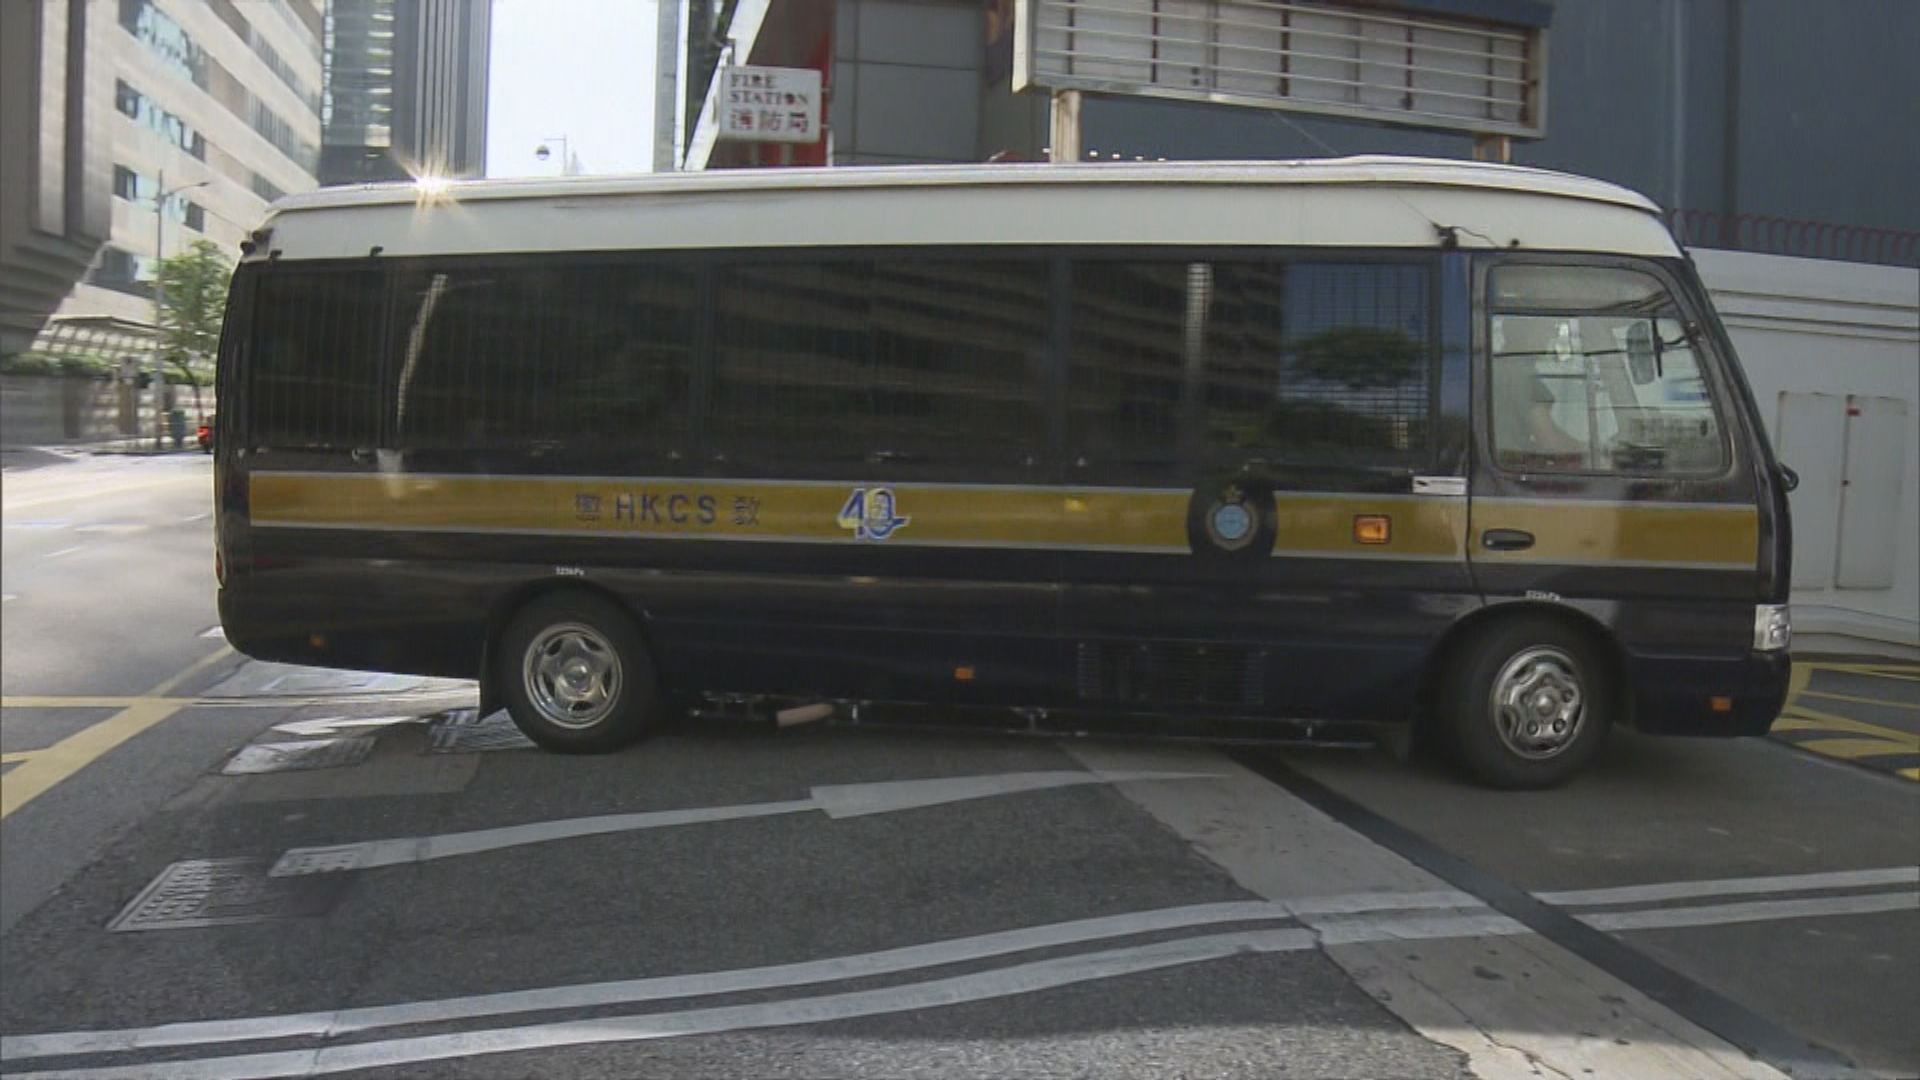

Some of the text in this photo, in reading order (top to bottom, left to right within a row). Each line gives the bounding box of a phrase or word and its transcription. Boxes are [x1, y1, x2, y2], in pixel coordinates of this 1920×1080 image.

[730, 73, 777, 89] FIRE
[729, 90, 809, 105] STATION
[615, 494, 717, 525] HKCS
[838, 487, 910, 540] 40
